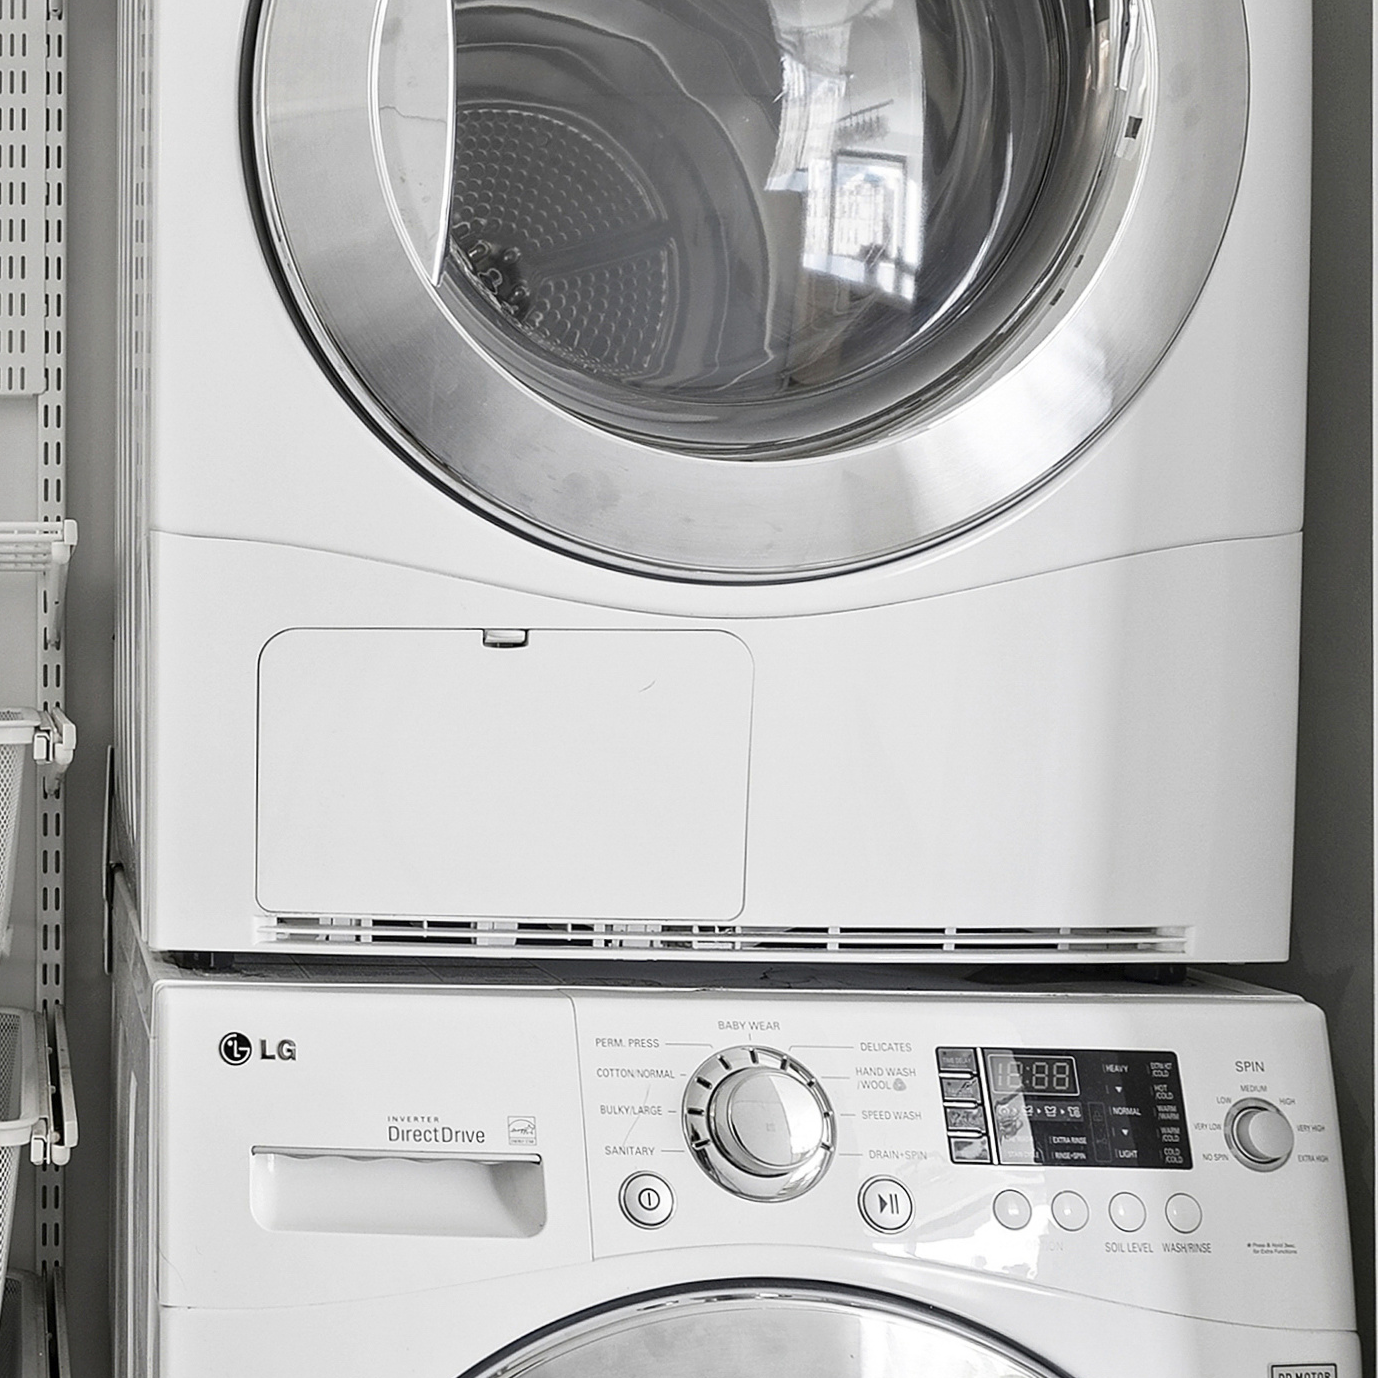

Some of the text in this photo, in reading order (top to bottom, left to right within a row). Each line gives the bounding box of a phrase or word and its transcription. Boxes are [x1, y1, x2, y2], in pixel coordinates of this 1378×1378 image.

[718, 1021, 781, 1031] BABY WEAR
[628, 1039, 660, 1048] PRESS
[860, 1042, 913, 1052] DELICATES
[260, 1038, 297, 1061] LG
[1105, 1064, 1129, 1073] HEAVY
[1234, 1060, 1266, 1073] SPIN
[596, 1068, 675, 1079] COTTON/NORMAL
[855, 1067, 917, 1078] HAND WASH
[856, 1079, 892, 1091] /WOOL
[1240, 1084, 1268, 1093] MEDIUM
[1216, 1097, 1232, 1105] LOW
[1278, 1097, 1296, 1106] HIGH
[600, 1105, 663, 1116] BULKY/LARGE
[862, 1110, 922, 1121] SPEED WASH
[1112, 1106, 1142, 1116] NORMAL
[387, 1115, 440, 1124] INVERTER
[1193, 1123, 1222, 1131] VERY LOW
[1296, 1125, 1325, 1133] VERY HIGH
[387, 1125, 486, 1144] DirectDrive
[604, 1146, 656, 1157] SANITARY
[868, 1149, 928, 1161] DRAIN+SPIN
[1118, 1149, 1139, 1159] LIGHT
[1202, 1153, 1229, 1162] NO SPIN
[1297, 1155, 1315, 1163] EXTRA
[1104, 1241, 1154, 1254] SOIL LEVEL
[1162, 1242, 1212, 1255] WASH/RINSE
